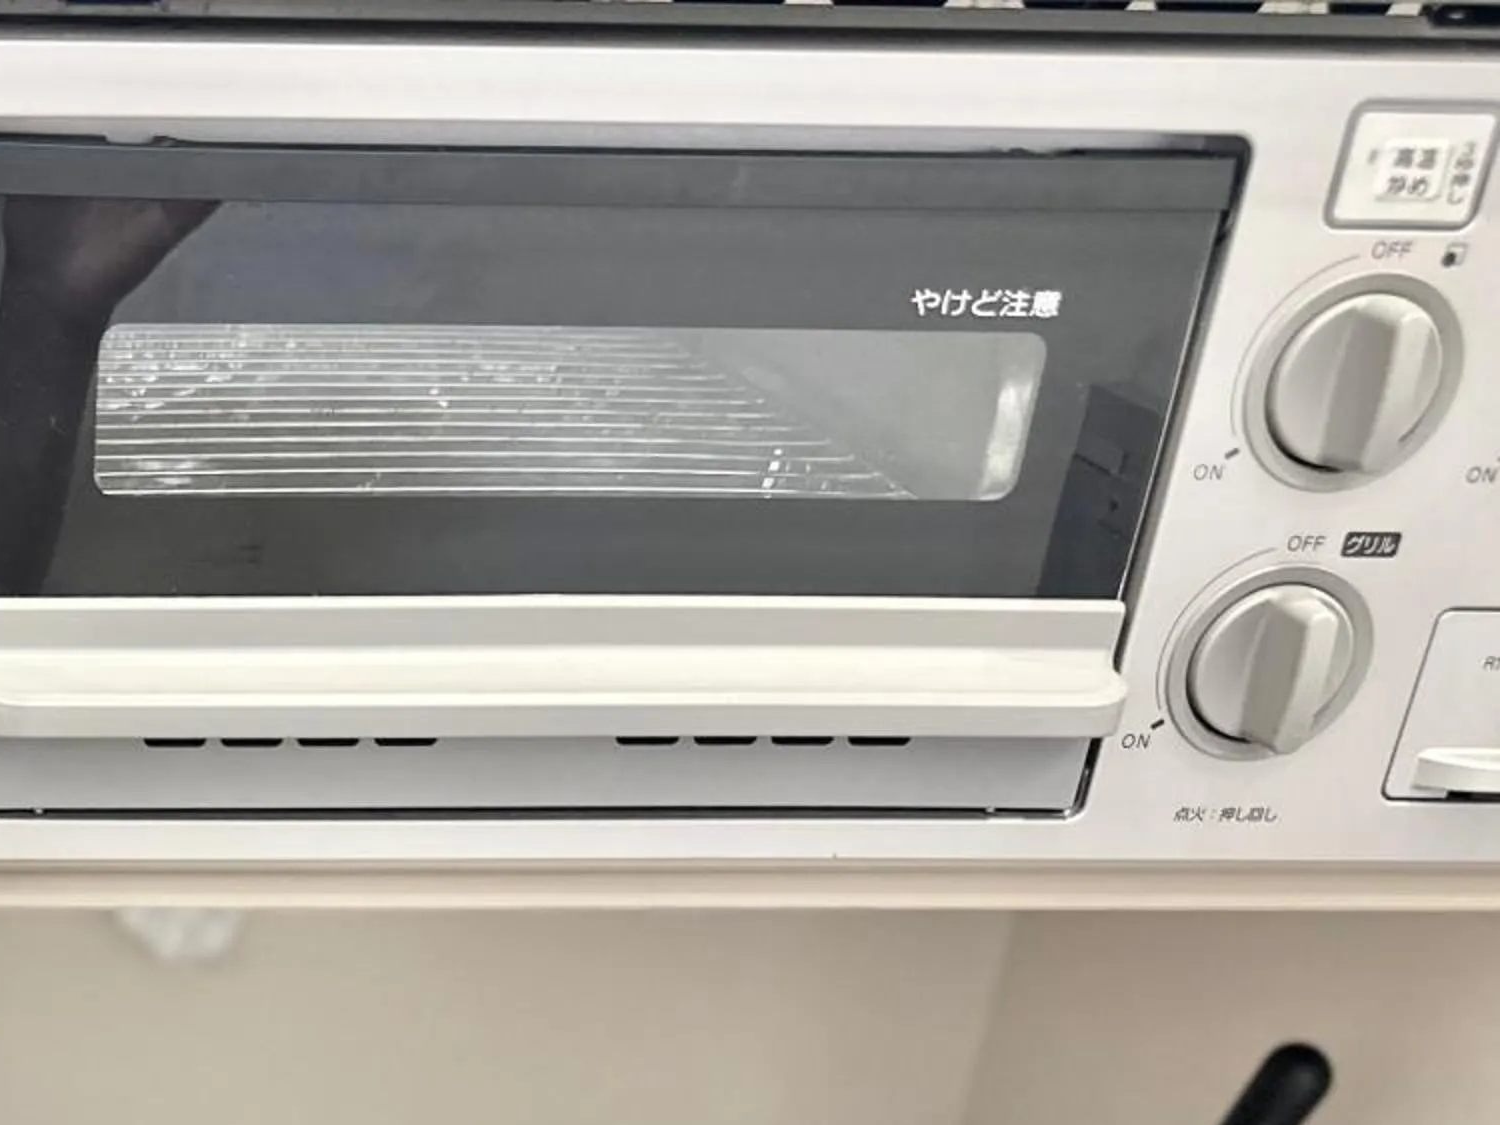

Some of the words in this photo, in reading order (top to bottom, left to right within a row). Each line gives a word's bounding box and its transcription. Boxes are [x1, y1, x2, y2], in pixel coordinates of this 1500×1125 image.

[1371, 240, 1413, 259] OFF
[911, 288, 1062, 318] やけど注意
[1193, 464, 1223, 481] ON
[1465, 466, 1500, 484] ON
[1287, 535, 1325, 552] OFF
[1344, 535, 1396, 555] グリル
[1120, 733, 1151, 750] ON
